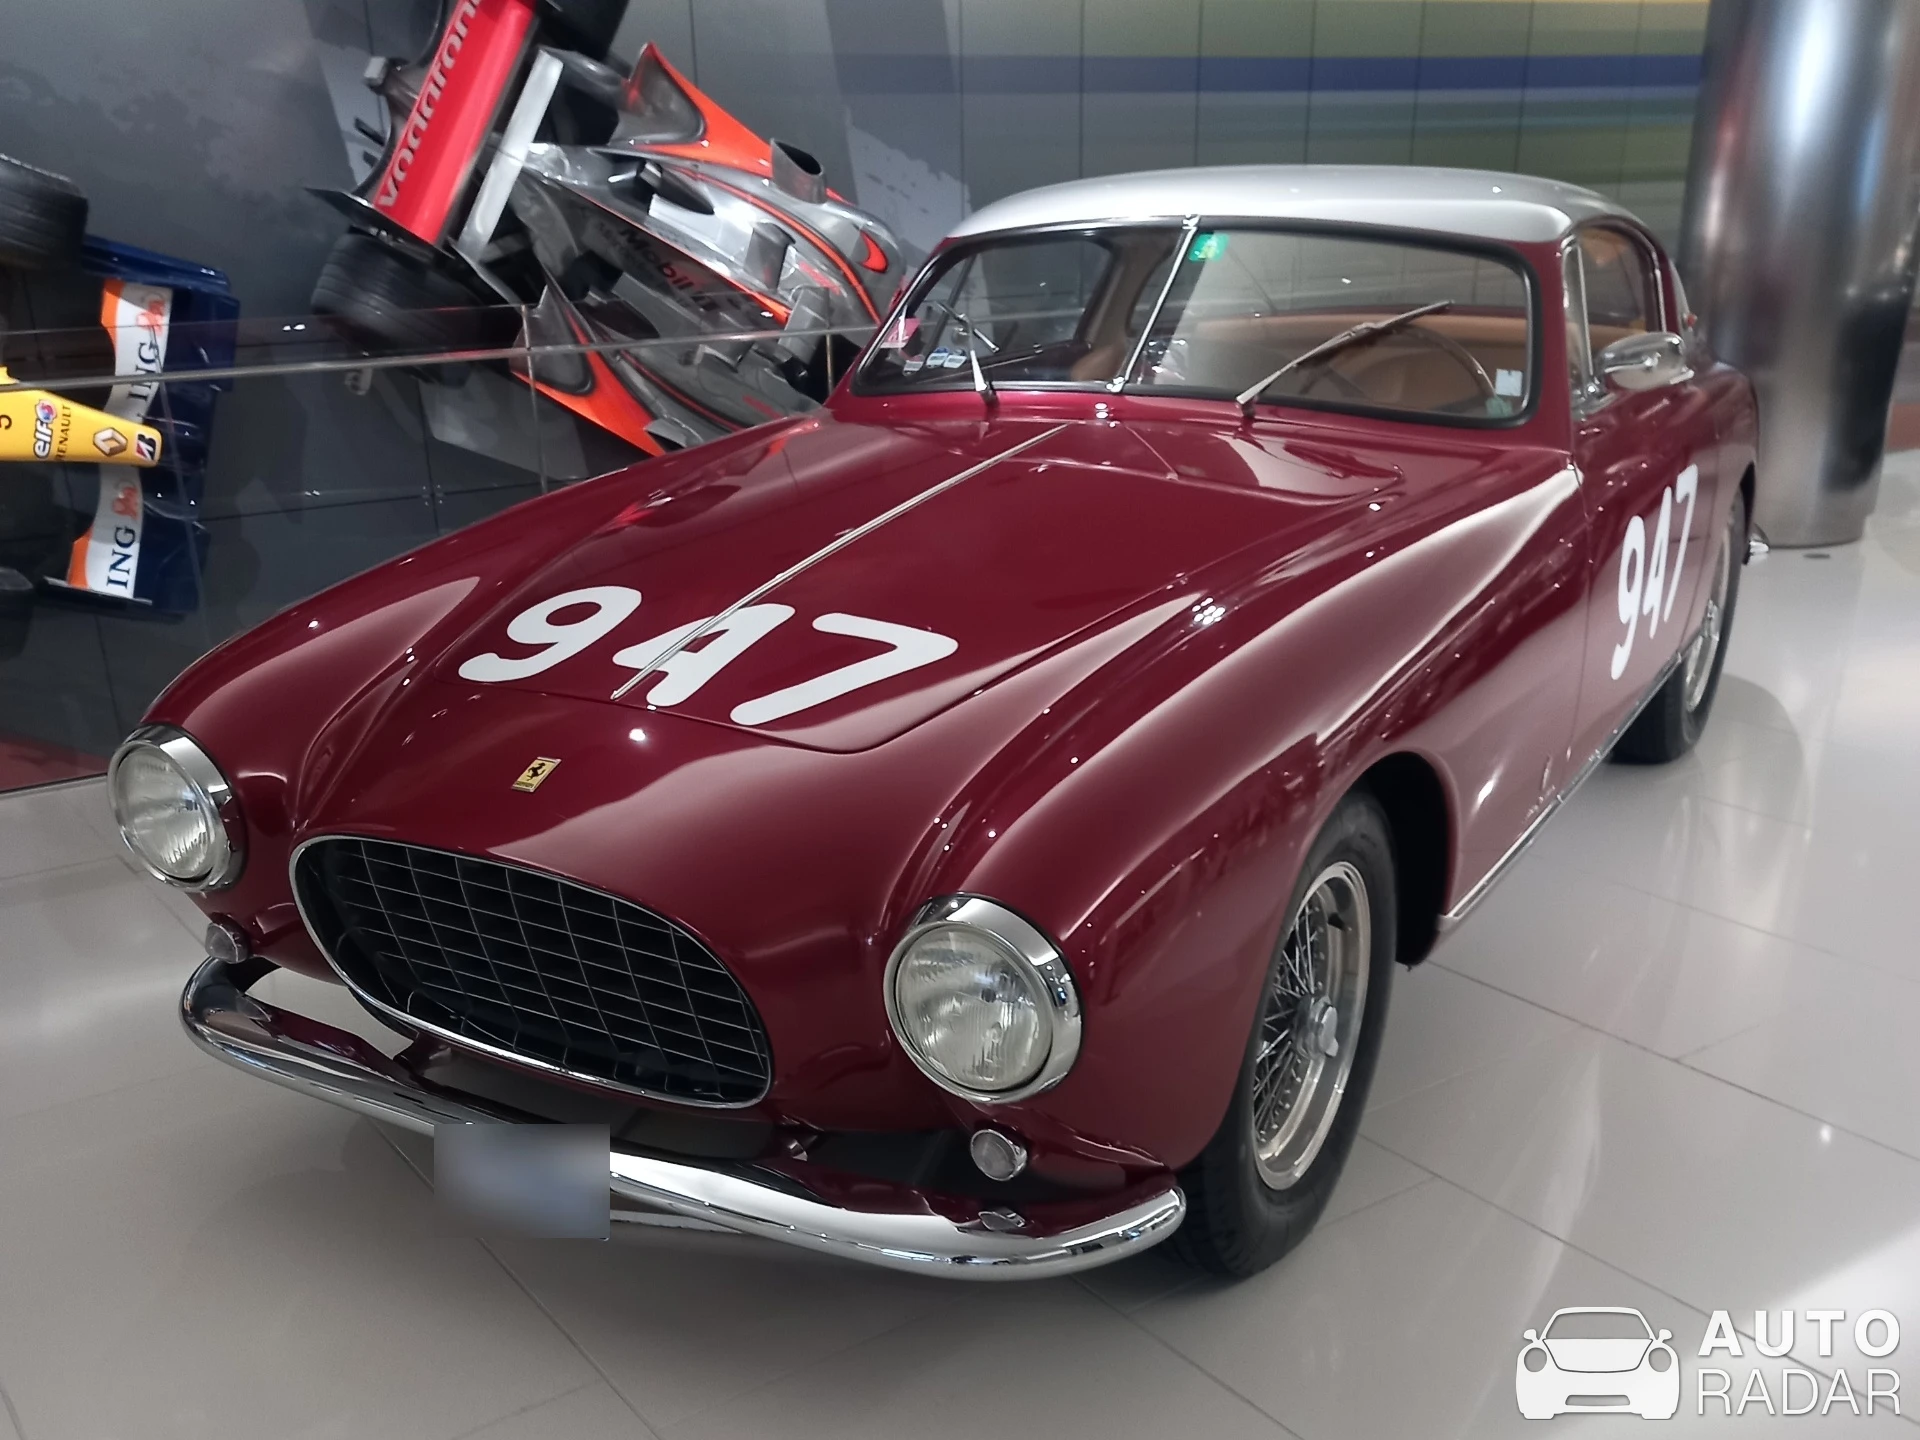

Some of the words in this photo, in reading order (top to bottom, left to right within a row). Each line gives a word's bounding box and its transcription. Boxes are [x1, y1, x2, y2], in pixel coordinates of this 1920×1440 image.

[378, 0, 481, 207] vodafon
[107, 525, 136, 589] ING
[1610, 463, 1699, 681] 947
[458, 585, 960, 725] 947
